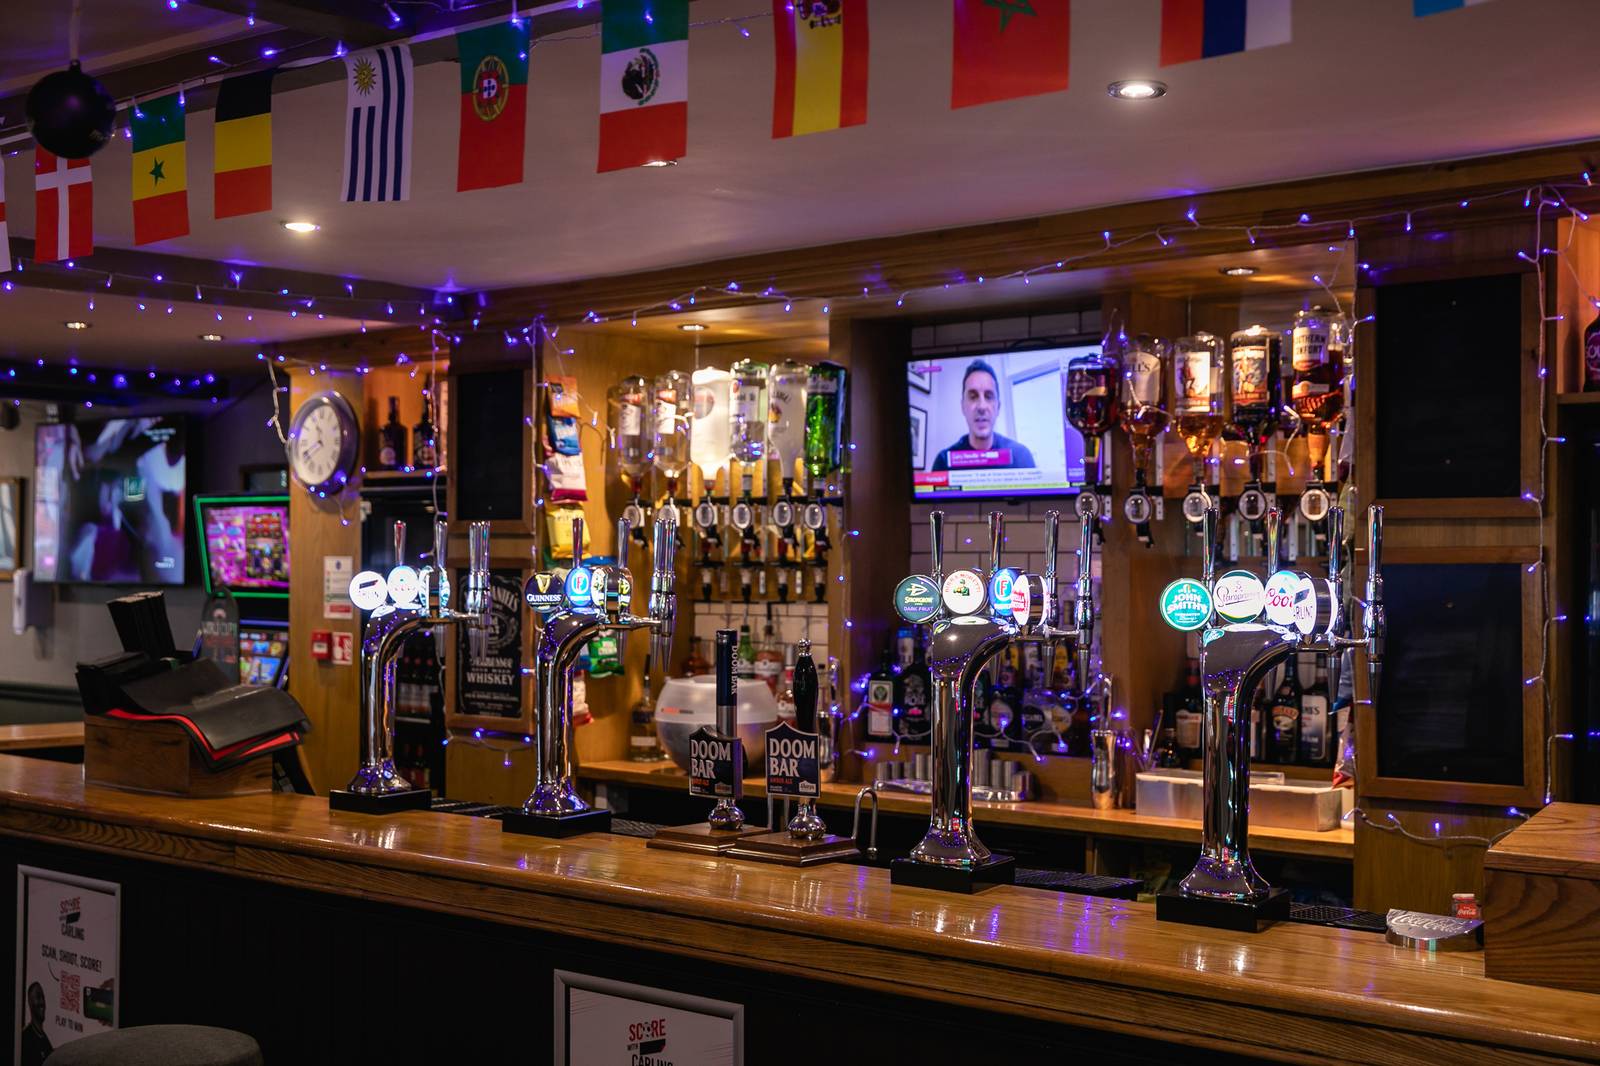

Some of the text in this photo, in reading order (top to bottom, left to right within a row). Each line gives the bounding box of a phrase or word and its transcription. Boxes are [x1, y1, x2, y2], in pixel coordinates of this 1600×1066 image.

[526, 593, 562, 602] GUINNESS
[1172, 593, 1202, 603] JOHN
[466, 672, 515, 686] WHISKEY
[690, 739, 731, 761] DOOM
[769, 738, 816, 760] DOOM
[690, 757, 716, 779] BAR
[769, 757, 800, 777] BAR
[59, 896, 81, 914] SCORE
[61, 923, 85, 941] CARLING
[59, 949, 79, 967] SHOOT,
[79, 955, 102, 973] SCORE!
[55, 1015, 84, 1033] PLAY TO WIN
[629, 1019, 666, 1041] SCORE
